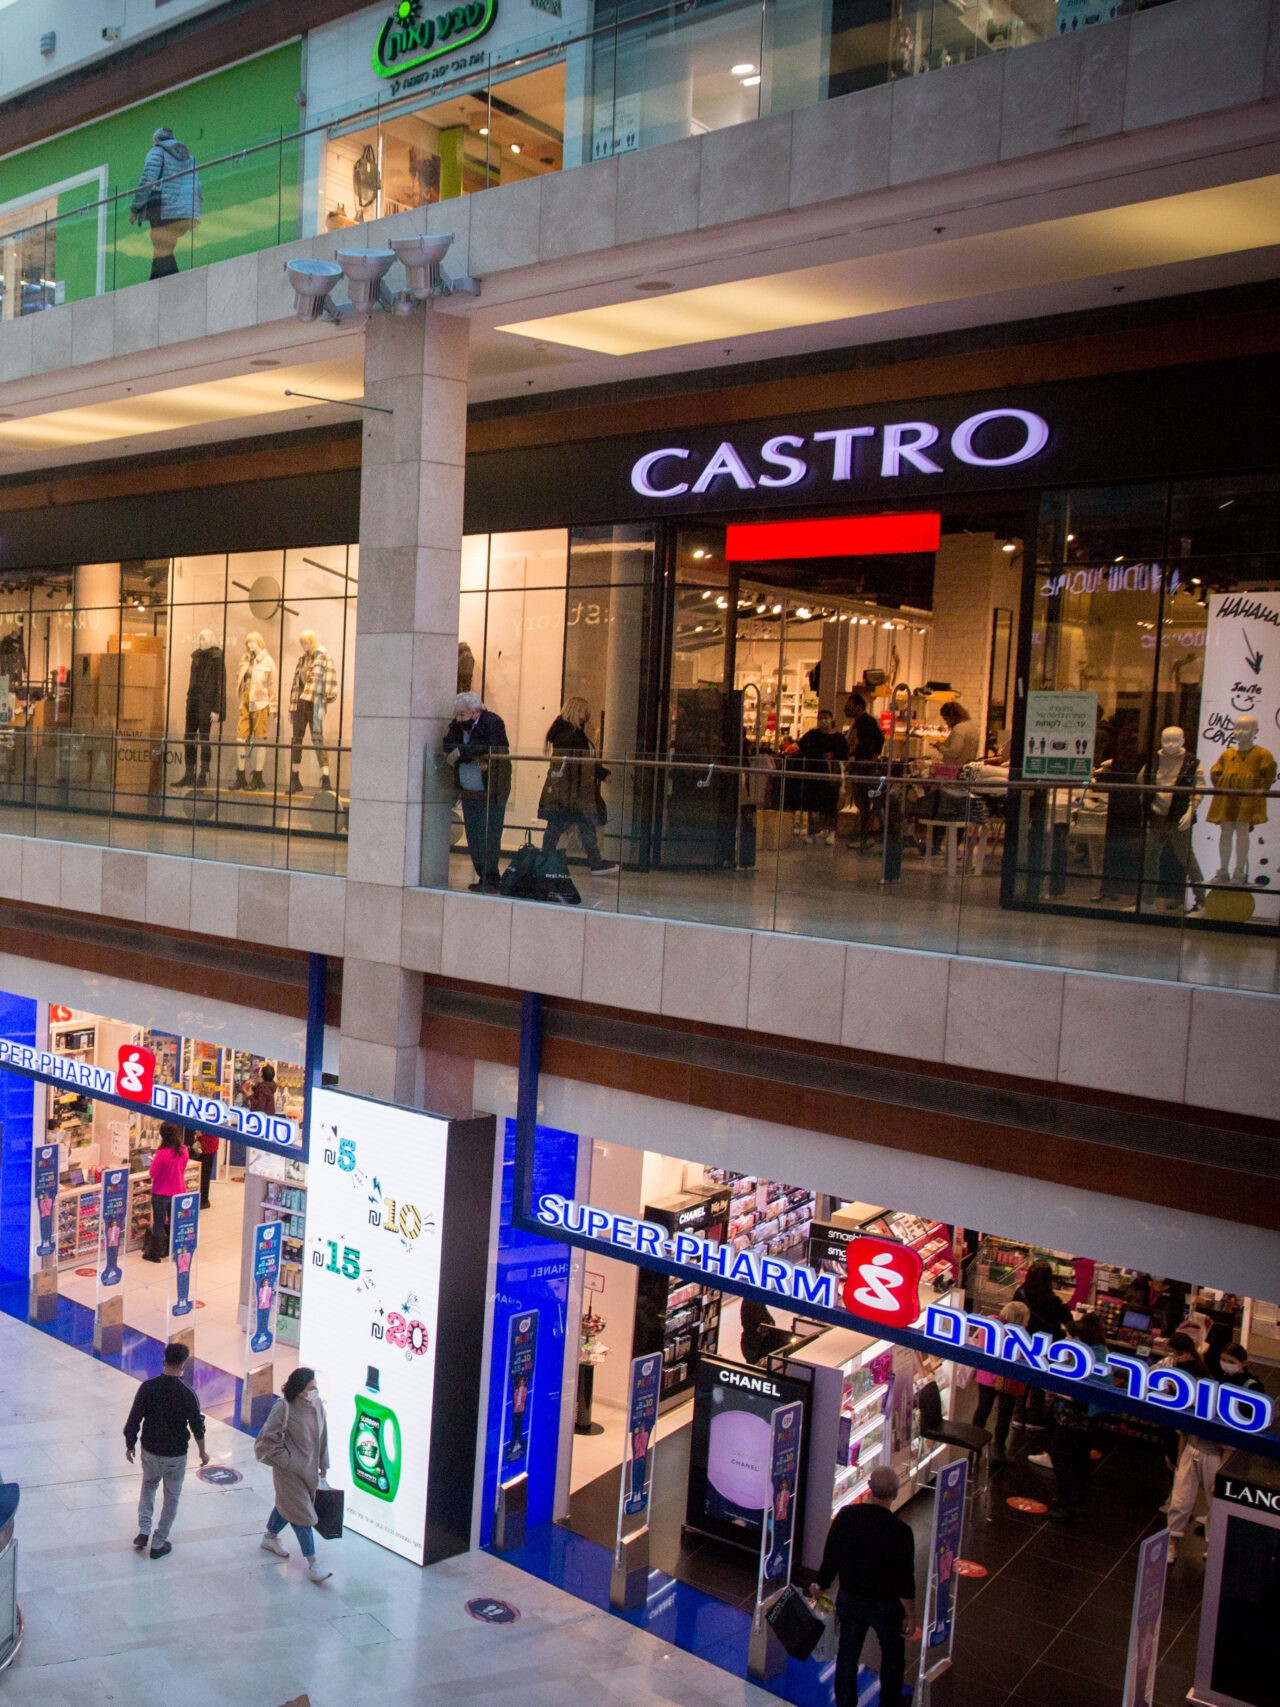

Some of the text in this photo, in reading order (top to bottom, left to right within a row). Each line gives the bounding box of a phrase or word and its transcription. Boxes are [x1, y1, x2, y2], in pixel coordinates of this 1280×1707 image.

[387, 18, 435, 61] נאות
[436, 1, 485, 40] טבע
[630, 407, 1050, 498] CASTRO
[152, 1085, 296, 1145] סופר-פארם
[679, 1206, 706, 1225] CHANEL
[537, 1193, 839, 1309] SUPER-PHARM
[719, 1370, 781, 1397] CHANEL
[924, 1302, 1274, 1432] סופר-פארם
[730, 1458, 760, 1472] CHANEL
